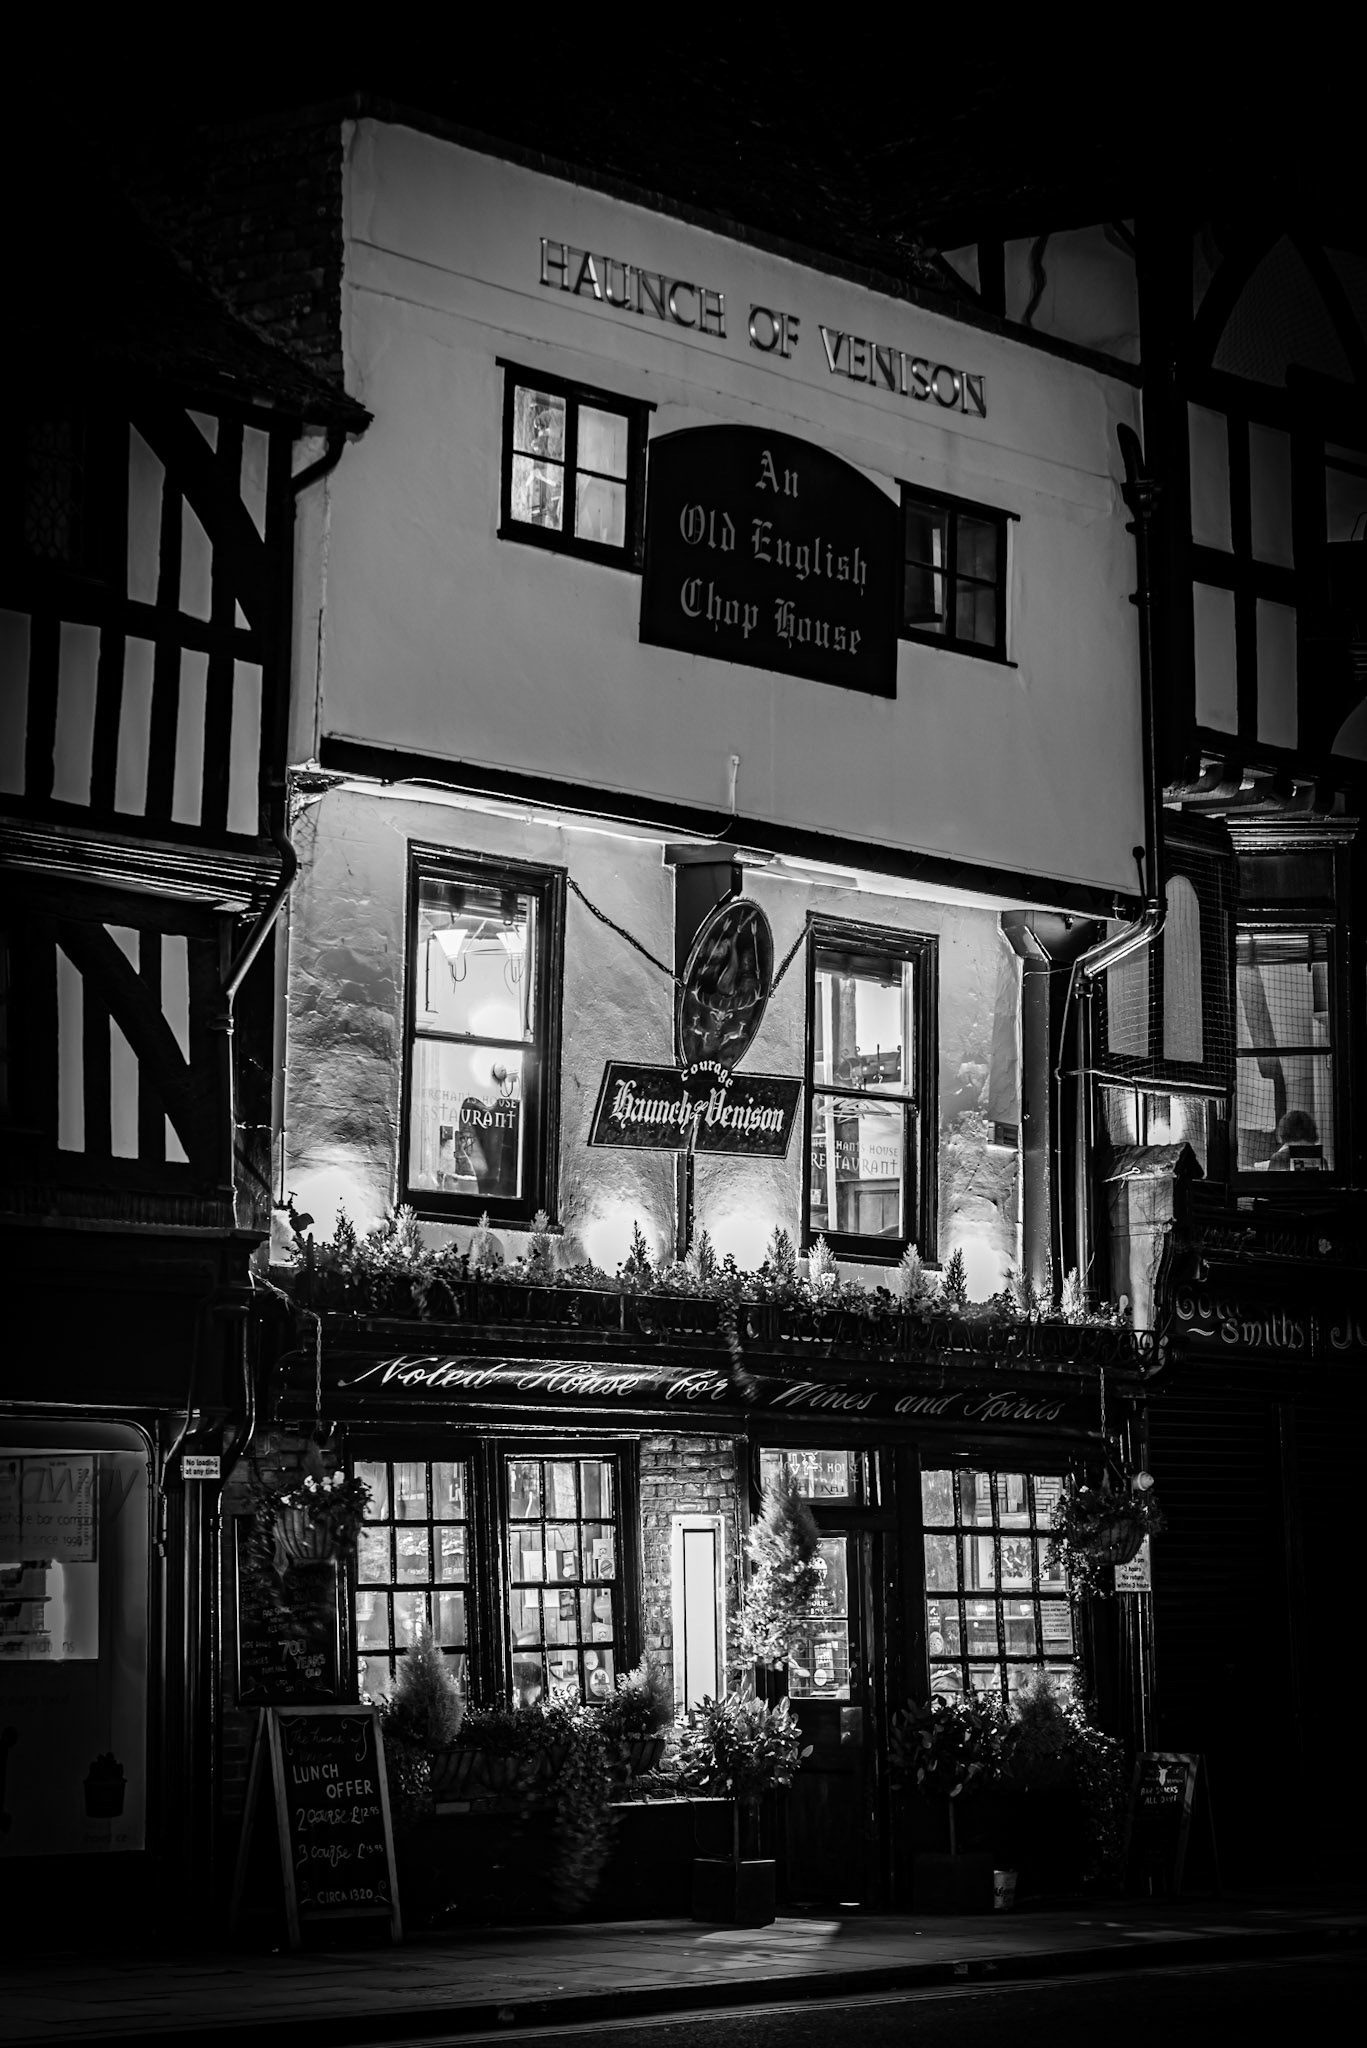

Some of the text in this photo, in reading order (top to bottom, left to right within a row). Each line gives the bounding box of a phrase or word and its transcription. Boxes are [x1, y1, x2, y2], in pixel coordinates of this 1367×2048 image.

[540, 237, 986, 418] HAUNCH OF VENISON
[755, 450, 800, 499] An
[679, 503, 867, 595] Old English
[680, 576, 862, 655] Chop House
[609, 1079, 692, 1134] Haunch
[704, 1088, 785, 1136] Venison
[869, 1145, 899, 1157] HOUSE
[811, 1152, 899, 1175] RETAURANT
[336, 1355, 1066, 1421] Noted House for Wines and Spirits
[278, 1638, 307, 1663] 700
[293, 1652, 326, 1670] YEARS
[305, 1667, 322, 1679] OLD
[292, 1763, 340, 1784] LUNCH
[325, 1779, 374, 1800] OFFER
[316, 1888, 373, 1904] CIRCA 1320
